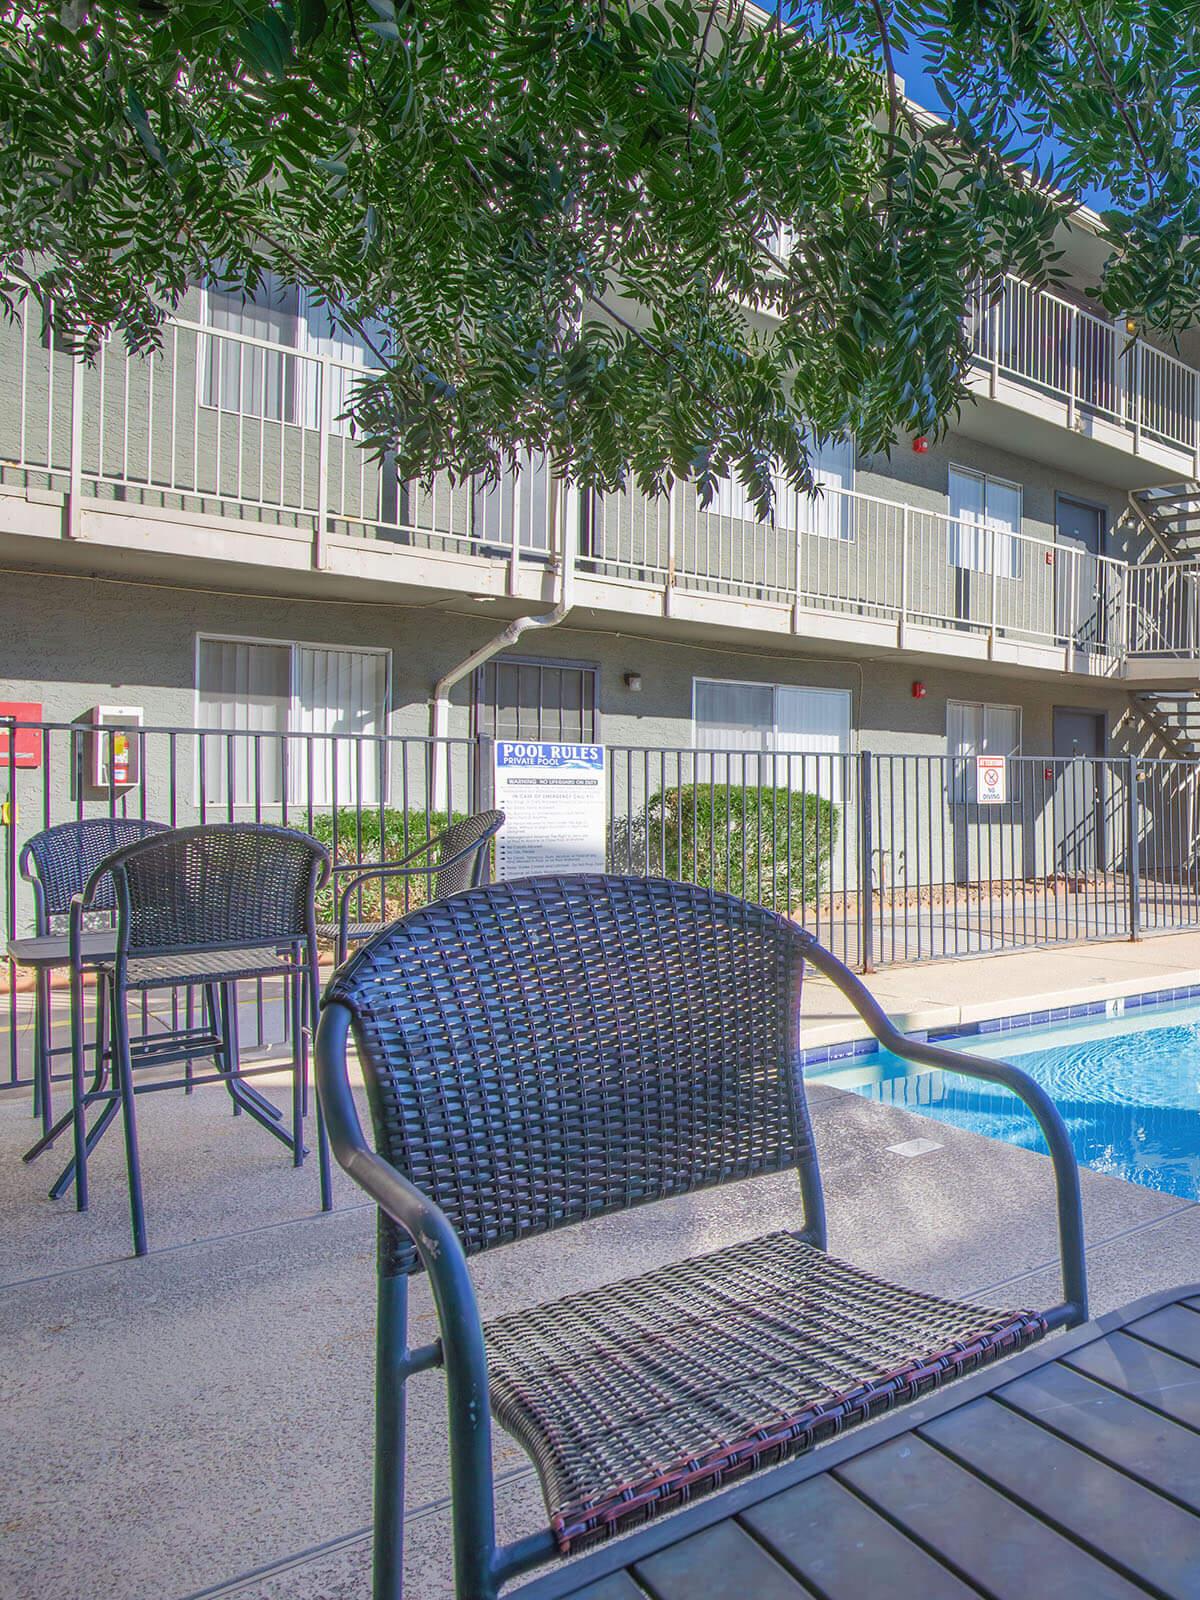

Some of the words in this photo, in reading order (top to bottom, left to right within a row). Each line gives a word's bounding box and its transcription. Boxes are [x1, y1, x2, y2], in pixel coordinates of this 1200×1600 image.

[503, 744, 546, 758] POOL
[551, 746, 598, 760] RULES
[503, 757, 534, 765] PRIVATE
[537, 758, 559, 766] POOL
